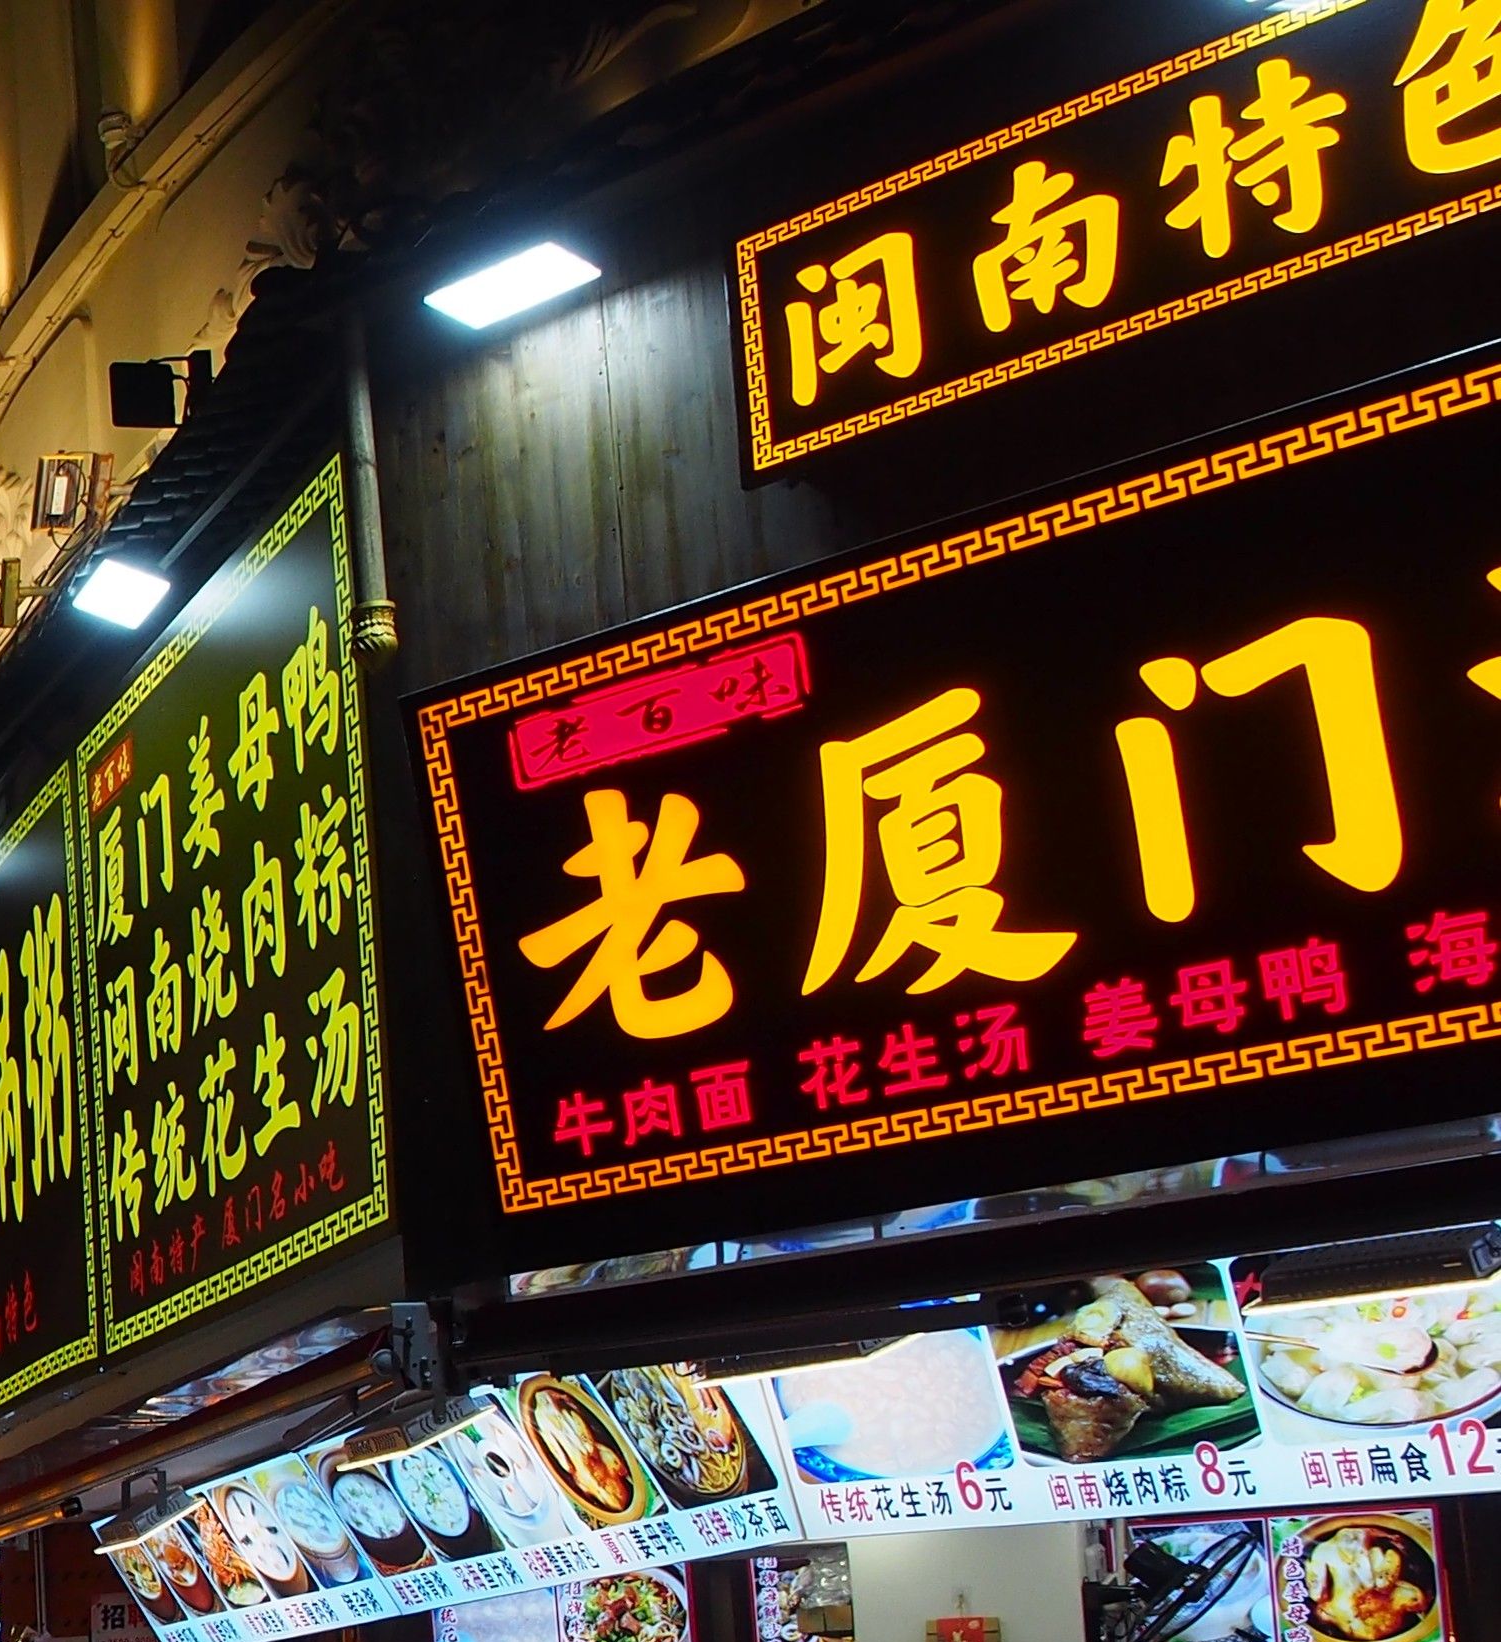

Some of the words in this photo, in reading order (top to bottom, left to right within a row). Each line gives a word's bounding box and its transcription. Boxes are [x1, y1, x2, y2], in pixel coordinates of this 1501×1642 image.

[530, 655, 794, 773] 老百味
[98, 605, 342, 947] 厦门姜母鸭
[519, 565, 1501, 1040] 老厦门
[103, 789, 353, 1098] 闽南烧肉粽
[554, 1058, 752, 1160] 牛肉面
[800, 1004, 1030, 1112] 花生汤
[1084, 937, 1348, 1061] 姜母鸭
[109, 965, 359, 1244] 传统花生汤
[129, 1214, 207, 1299] 闽南特产
[221, 1138, 346, 1252] 厦门名小吃
[821, 1483, 952, 1523] 传统花生汤
[955, 1462, 1013, 1513] 6元
[1050, 1466, 1186, 1510] 闽南烧肉粽
[1196, 1442, 1256, 1496] 8元
[1303, 1442, 1430, 1489] 闽南扁食
[1428, 1420, 1501, 1477] 12
[523, 1541, 600, 1579] 招牌蟹黄汤包
[600, 1521, 686, 1564] 厦门姜母鸭
[691, 1497, 790, 1546] 招牌沙茶面
[453, 1557, 523, 1591] 深海鱼片粥
